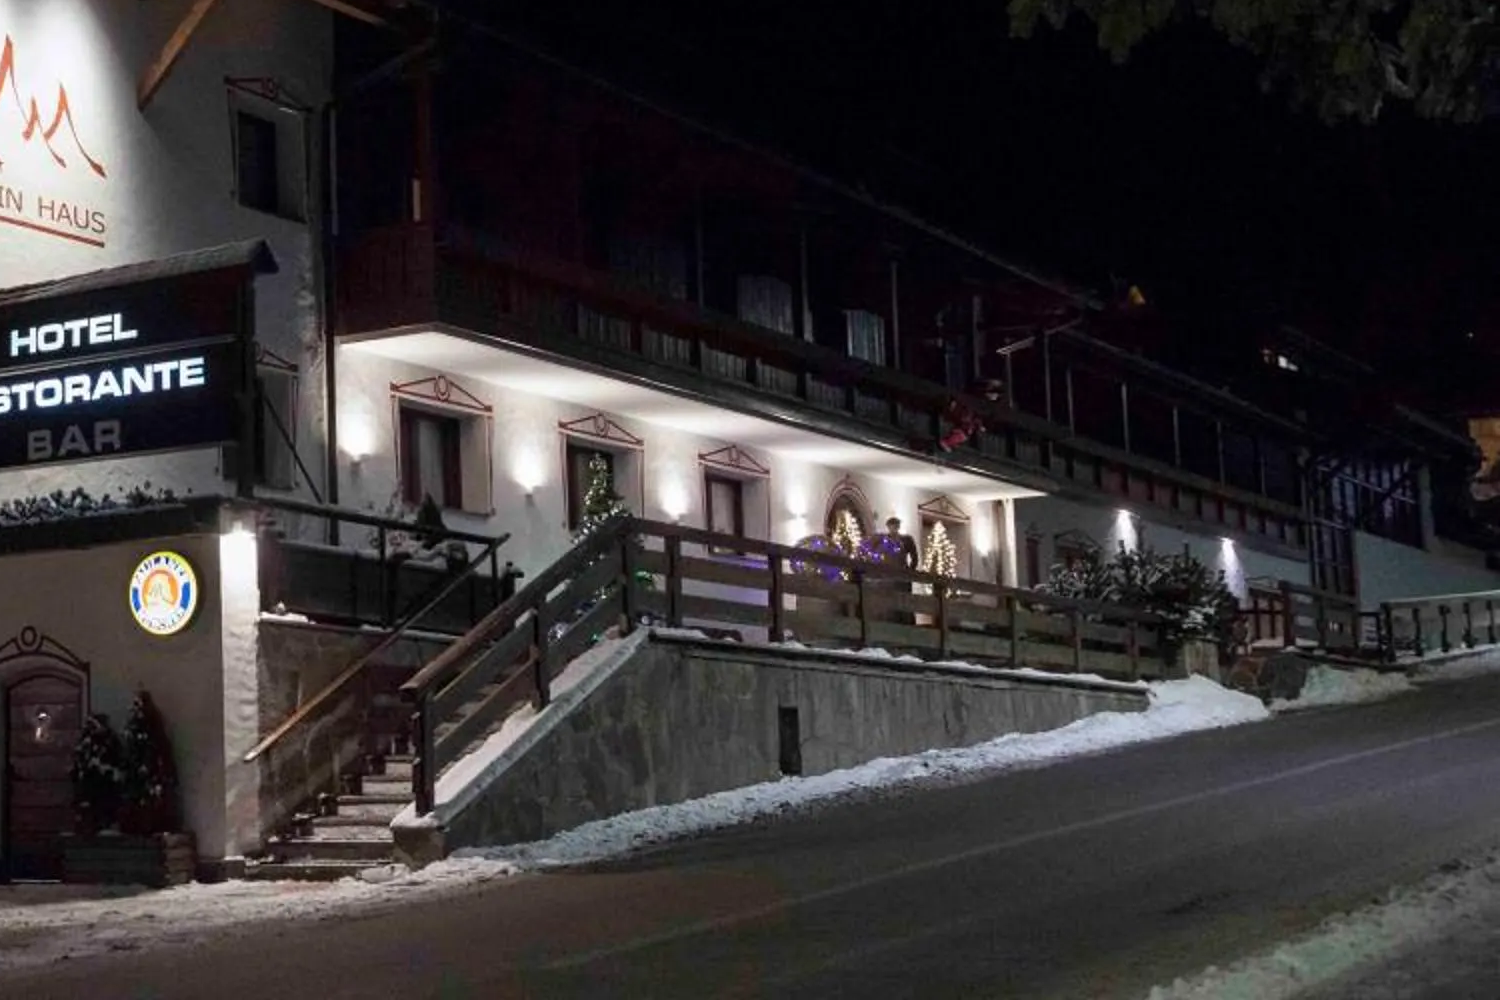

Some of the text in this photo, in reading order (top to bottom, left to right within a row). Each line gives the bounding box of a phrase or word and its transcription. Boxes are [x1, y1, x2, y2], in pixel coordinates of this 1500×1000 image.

[37, 196, 106, 234] HAUS
[10, 313, 138, 357] HOTEL
[27, 419, 122, 461] BAR
